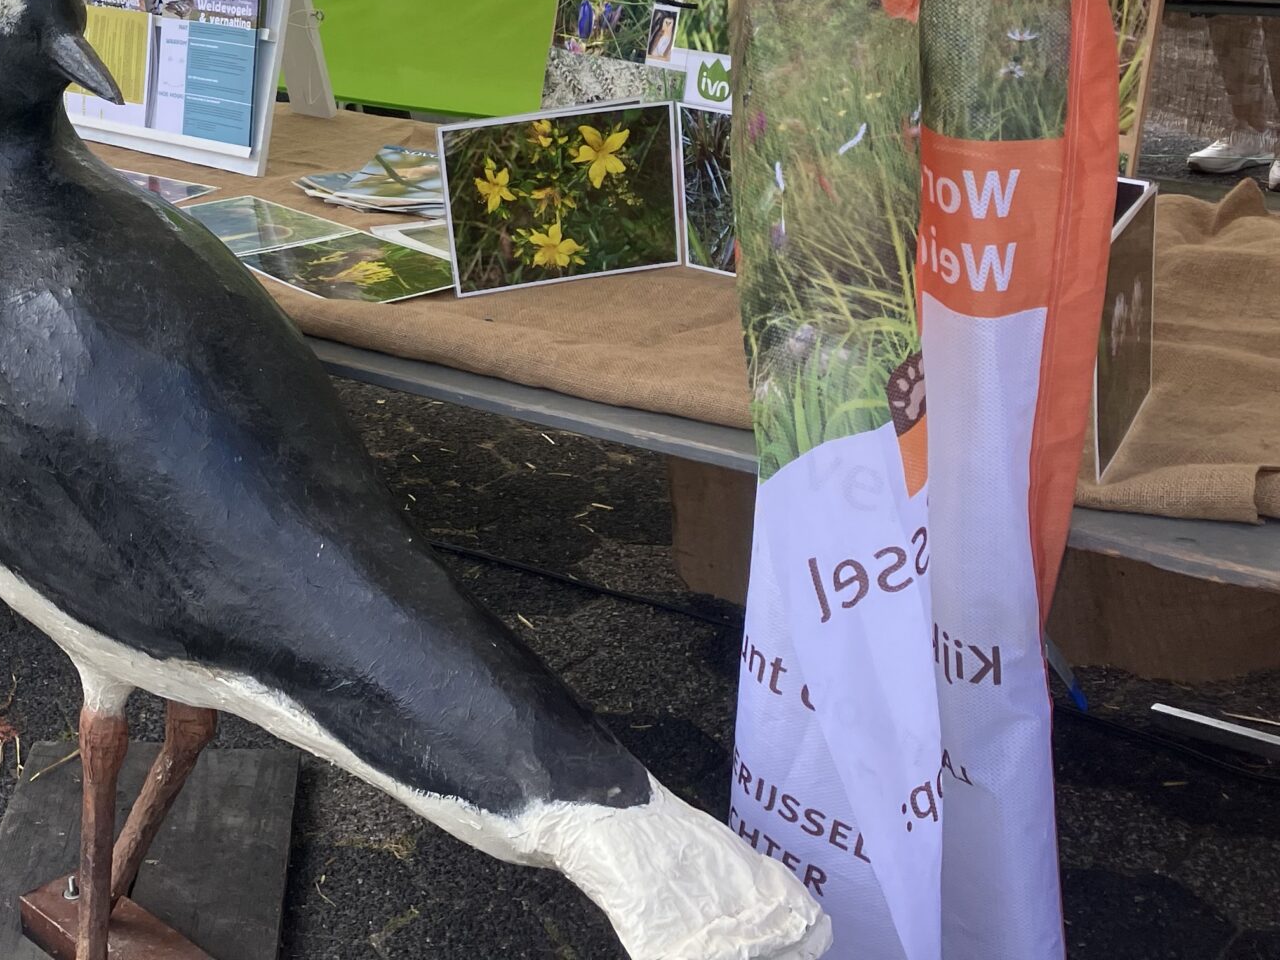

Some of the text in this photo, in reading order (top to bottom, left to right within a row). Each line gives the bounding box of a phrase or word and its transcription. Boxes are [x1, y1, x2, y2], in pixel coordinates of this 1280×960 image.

[199, 12, 252, 31] & vernatting
[701, 71, 730, 98] ivn
